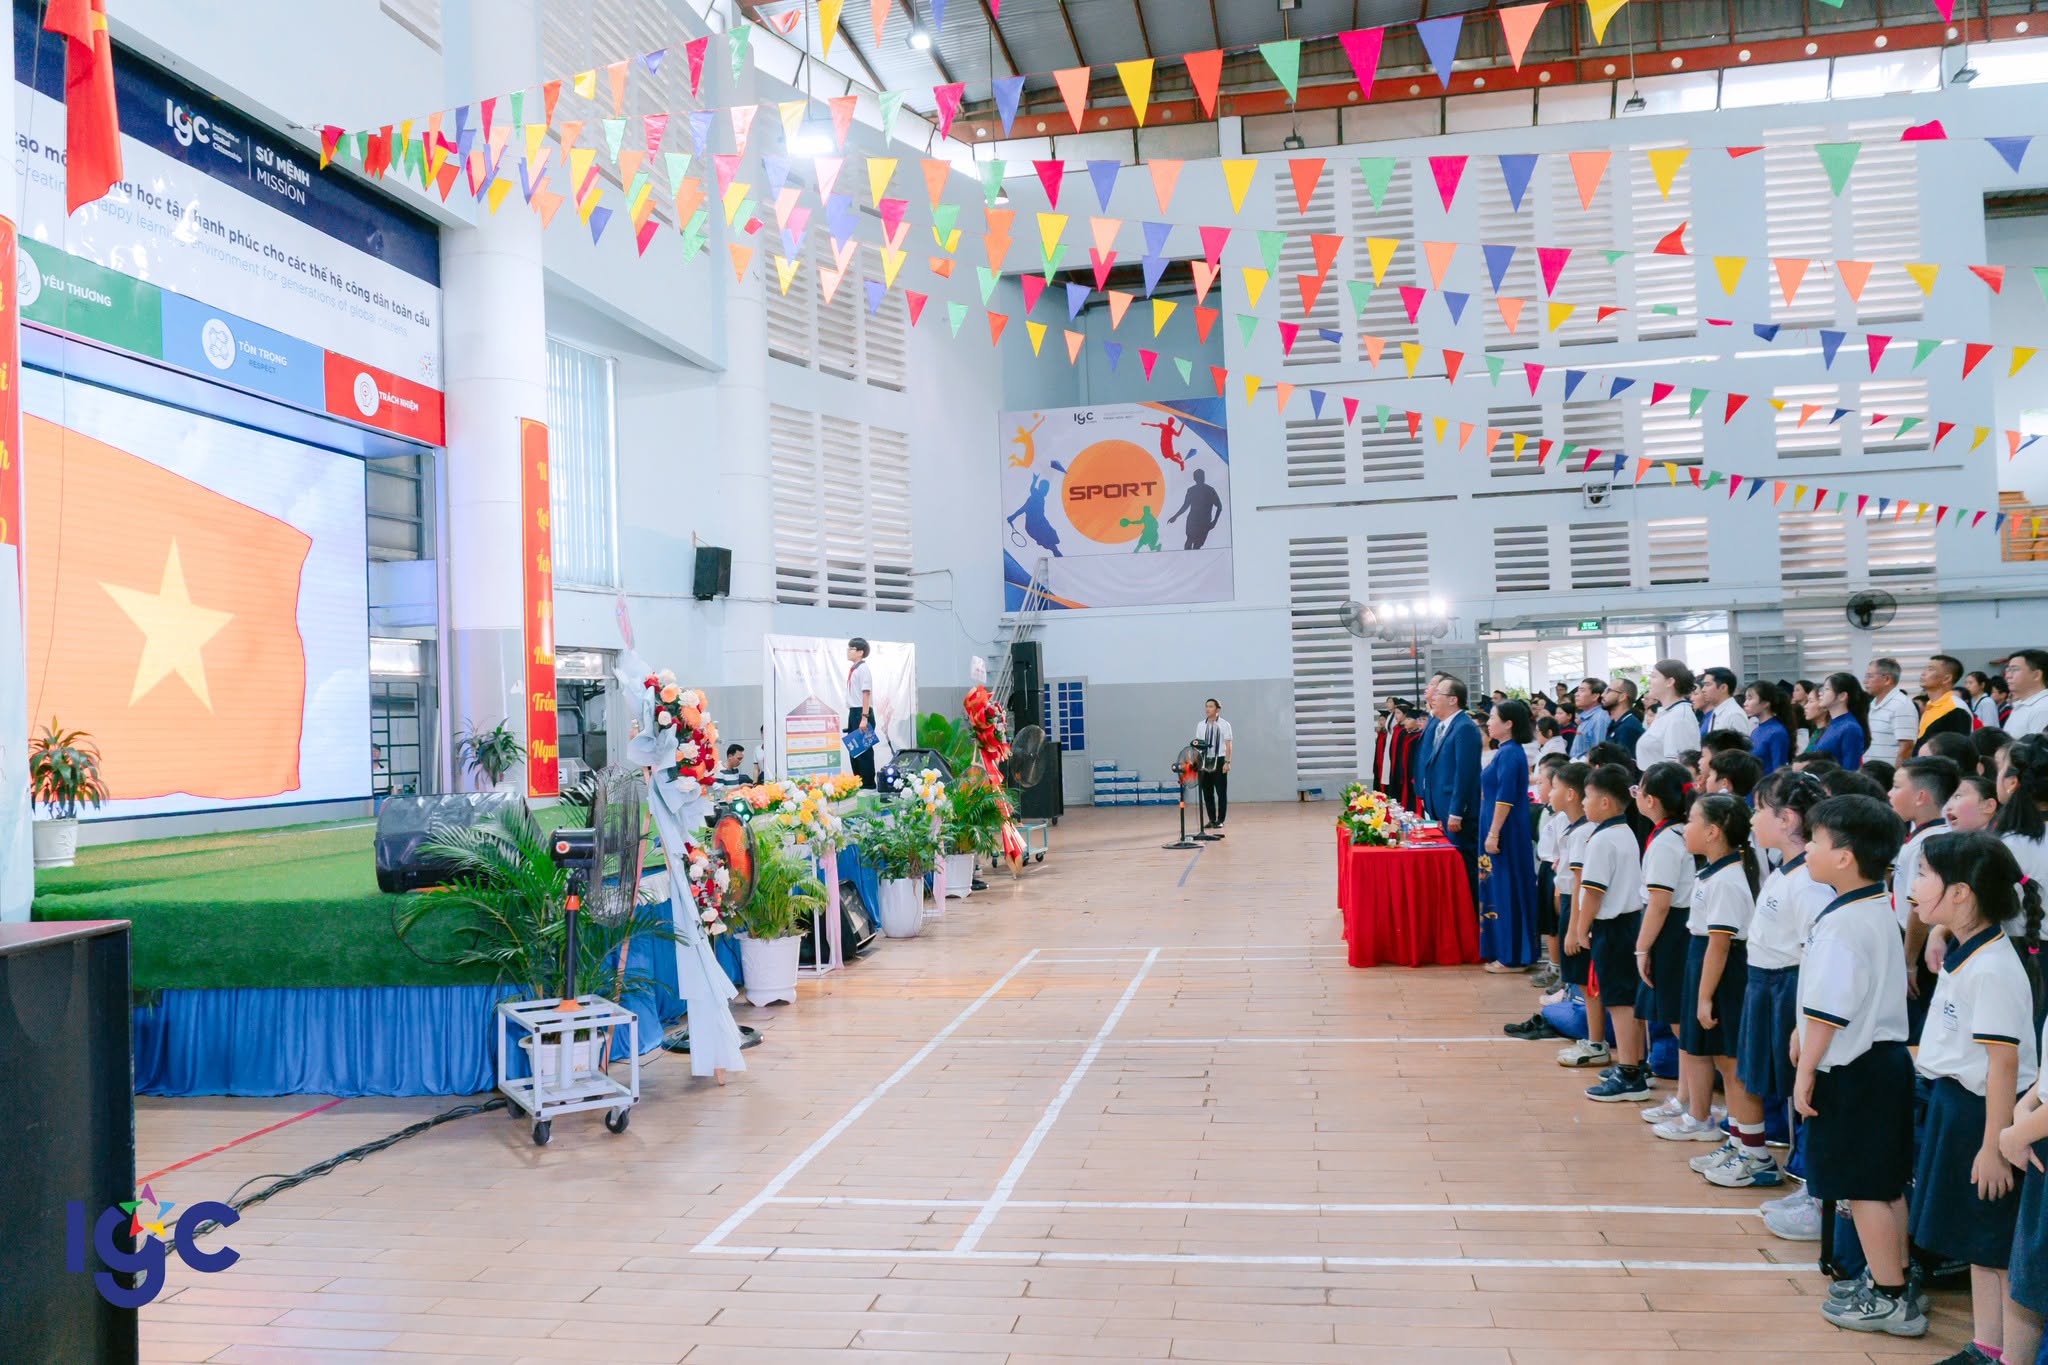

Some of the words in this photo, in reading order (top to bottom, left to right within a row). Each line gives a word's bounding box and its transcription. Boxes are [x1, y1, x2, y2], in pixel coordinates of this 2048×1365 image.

[256, 167, 305, 205] MISSION
[276, 156, 310, 186] MỆNH
[15, 131, 39, 153] ạo
[137, 183, 161, 209] học
[193, 209, 225, 237] hạnh
[229, 229, 259, 252] phúc
[263, 244, 284, 263] cho
[287, 255, 306, 273] các
[309, 263, 327, 282] thế
[345, 280, 370, 303] công
[100, 199, 132, 224] appy
[42, 273, 64, 291] YÊU
[66, 282, 112, 307] THƯƠNG
[1069, 481, 1157, 501] SPORT
